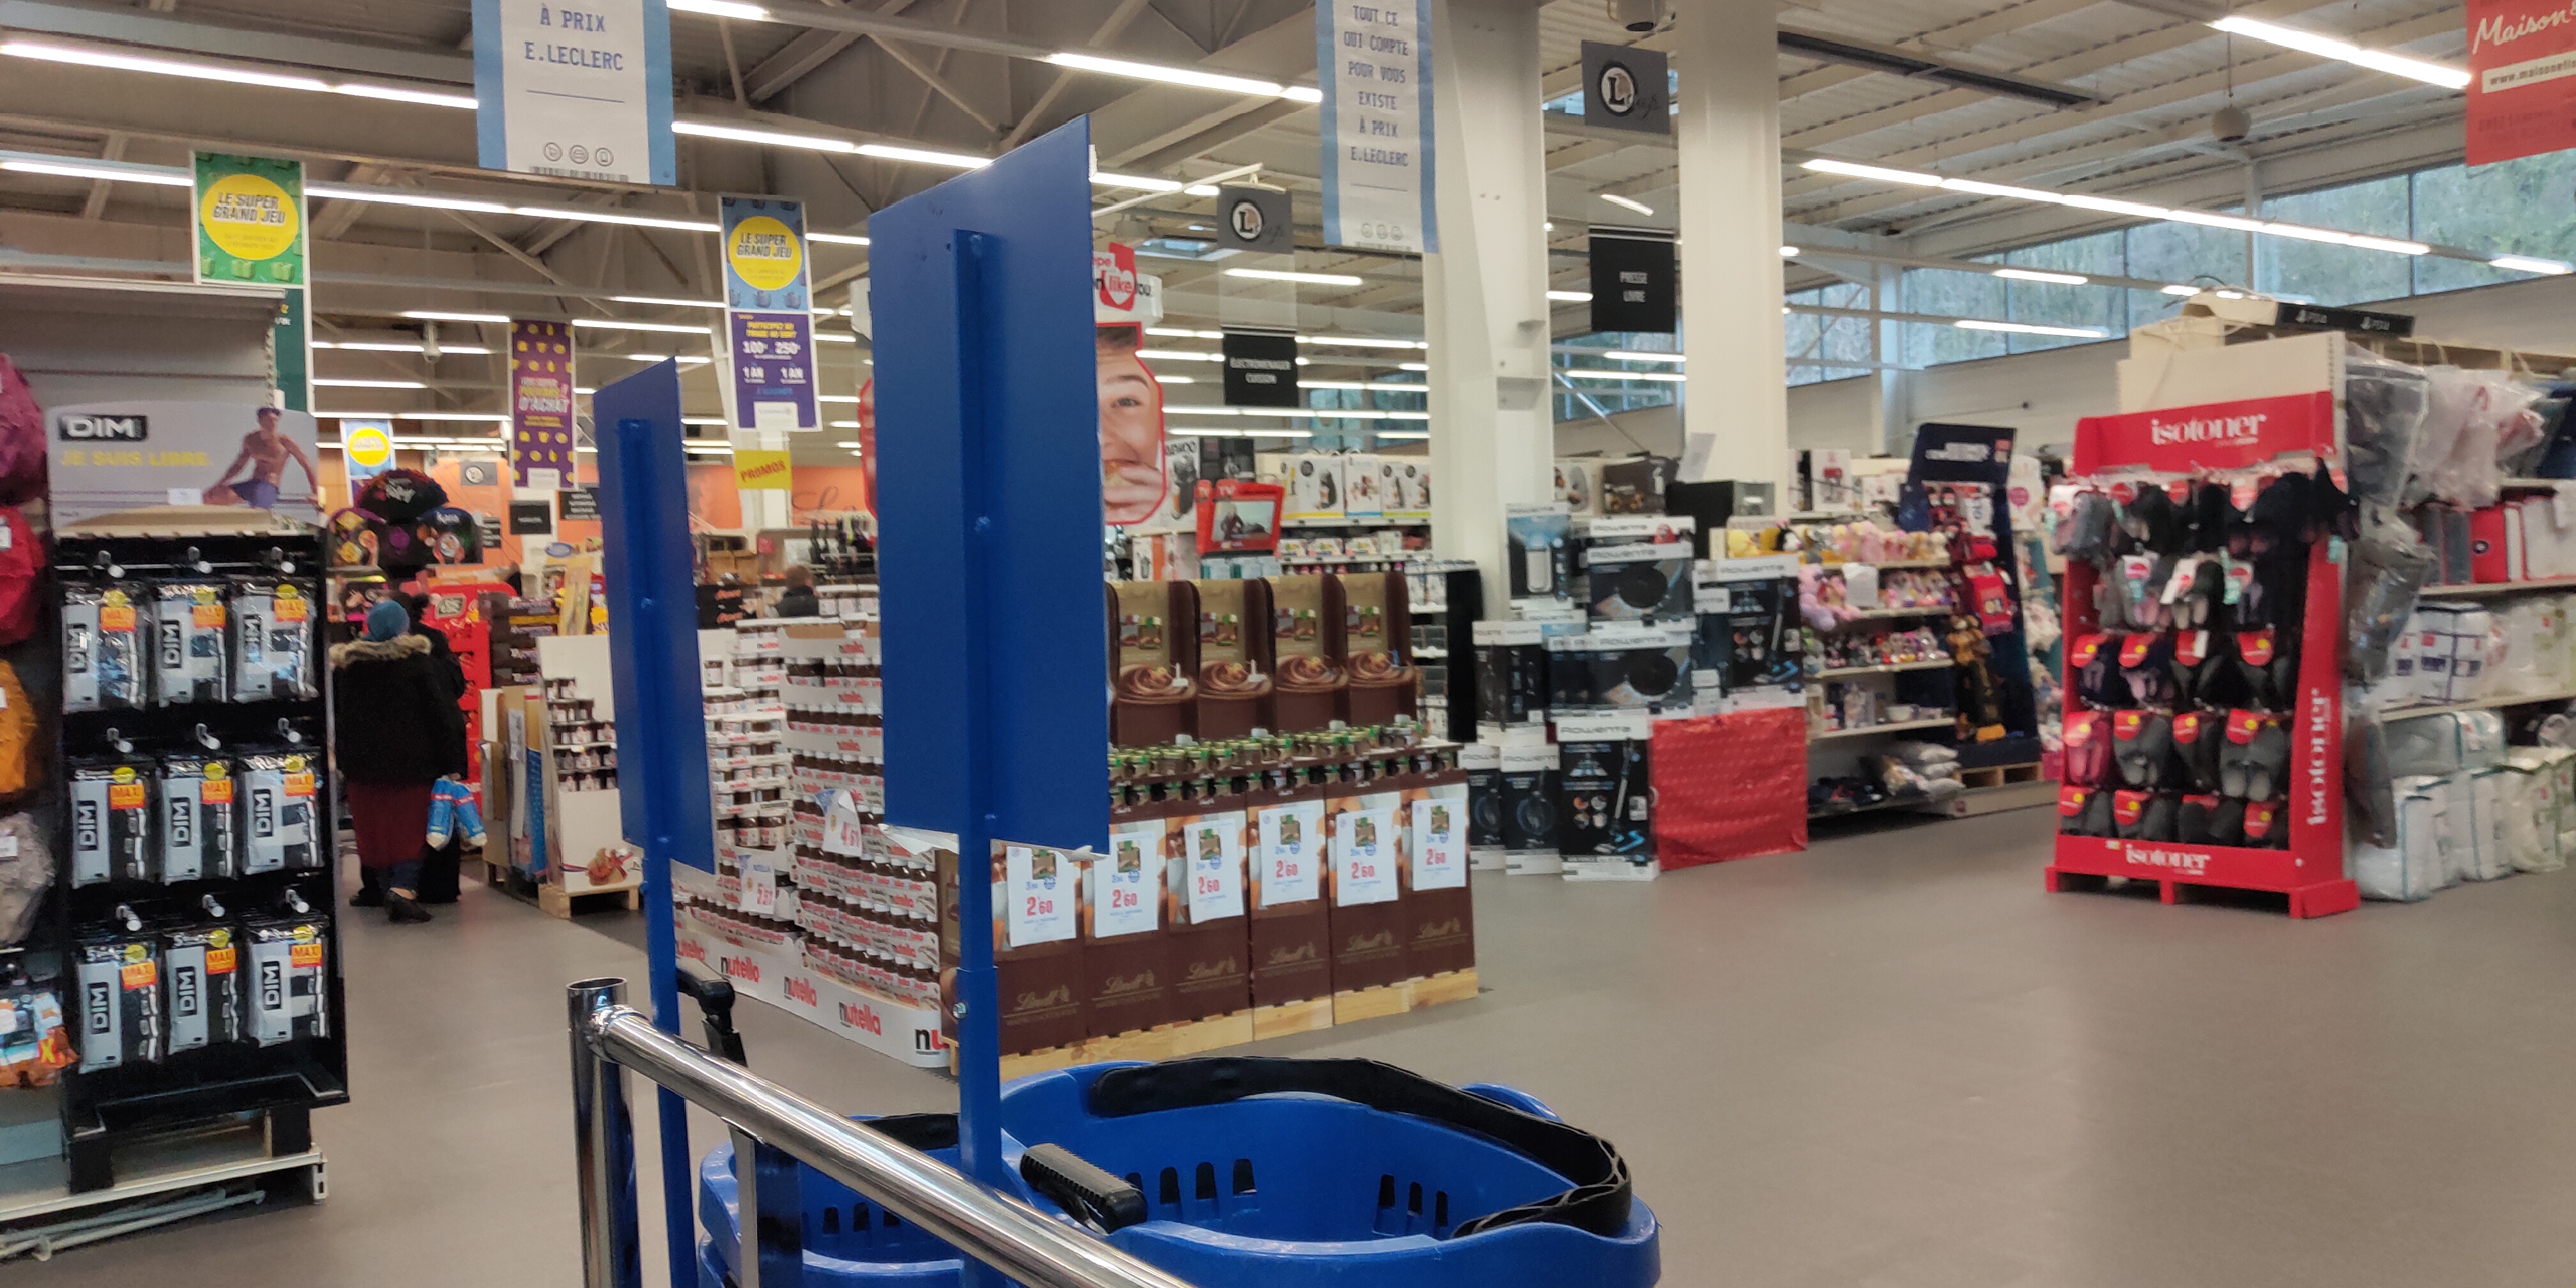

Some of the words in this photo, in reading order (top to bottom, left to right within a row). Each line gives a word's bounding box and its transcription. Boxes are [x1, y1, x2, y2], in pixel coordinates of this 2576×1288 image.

[540, 7, 551, 26] À
[561, 9, 606, 32] PRIX
[1353, 5, 1378, 22] TOUT
[1385, 12, 1398, 26] CE
[1344, 31, 1363, 49] QUI
[1369, 34, 1409, 56] COMPTE
[2471, 9, 2572, 56] Maison
[524, 42, 624, 71] E.LECLERC
[1348, 61, 1374, 78] POUR
[1380, 66, 1406, 84] VOUS
[1358, 91, 1397, 111] EXISTE
[1371, 119, 1399, 137] PRIX
[1350, 146, 1409, 167] E.LECLERC
[218, 192, 233, 204] LE
[236, 193, 280, 210] SUPER
[212, 206, 257, 222] GRAND
[261, 210, 286, 224] JEU
[737, 244, 770, 257] GRAND
[773, 246, 792, 257] JEU
[740, 232, 752, 243] LE
[755, 233, 786, 246] SUPER
[1108, 275, 1133, 294] like
[67, 417, 135, 438] DIM
[2150, 412, 2267, 446] isotoner
[740, 459, 786, 483] PROMOS
[163, 623, 182, 665] DIM
[2307, 687, 2329, 825] isotoner
[78, 804, 96, 846] DIM
[172, 802, 190, 843] DIM
[255, 793, 273, 833] DIM
[2126, 843, 2211, 869] isotoner
[720, 956, 761, 983] nutella
[178, 970, 197, 1012] DIM
[264, 965, 282, 1006] DIM
[784, 976, 818, 1008] nutella
[1101, 973, 1146, 995] Lindt
[92, 987, 110, 1030] DIM
[1013, 988, 1059, 1013] Lindt
[839, 1000, 882, 1036] nutella
